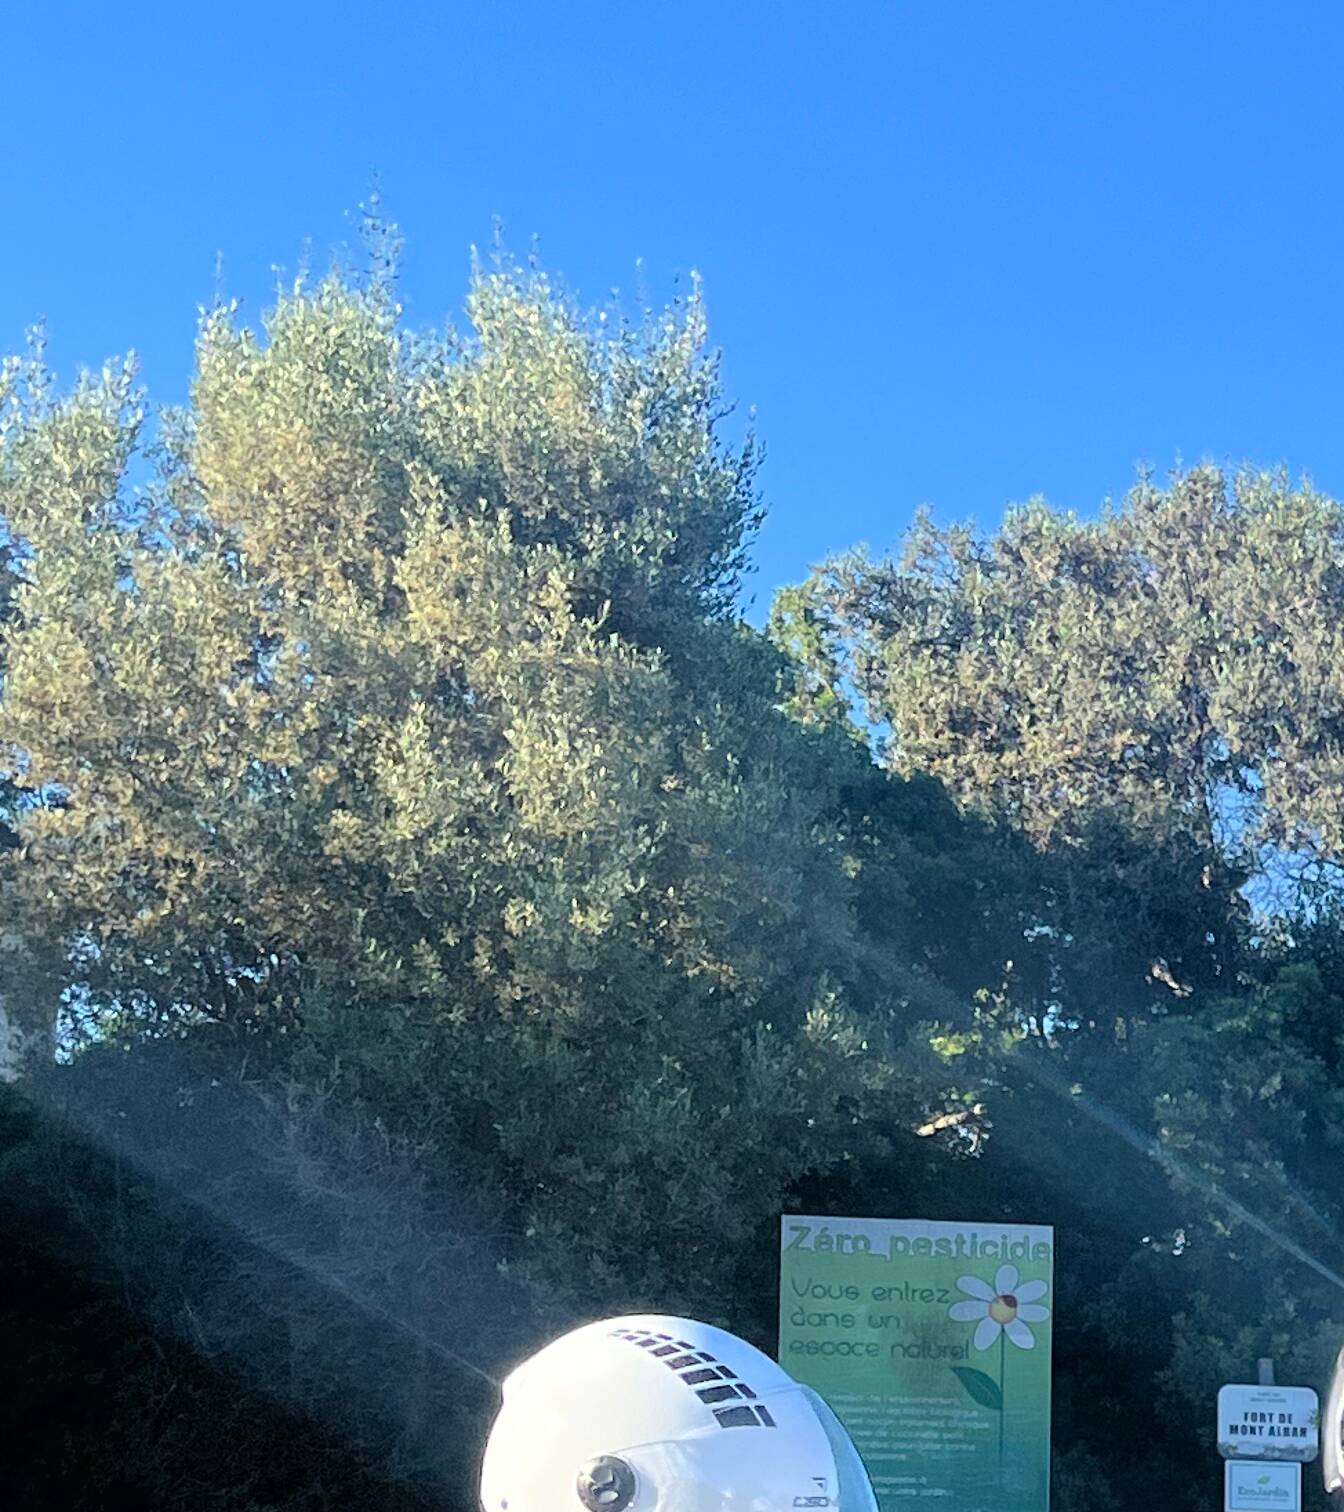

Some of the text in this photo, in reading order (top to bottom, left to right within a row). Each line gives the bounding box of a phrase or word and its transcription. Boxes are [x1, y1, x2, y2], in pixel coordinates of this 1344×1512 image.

[785, 1225, 1051, 1262] Zéro pesticide
[790, 1276, 951, 1304] Vous entrez
[789, 1304, 901, 1330] dans un
[788, 1338, 970, 1361] espace naturel
[1244, 1412, 1294, 1424] FORT DE
[1228, 1424, 1309, 1438] MONT ALBAN
